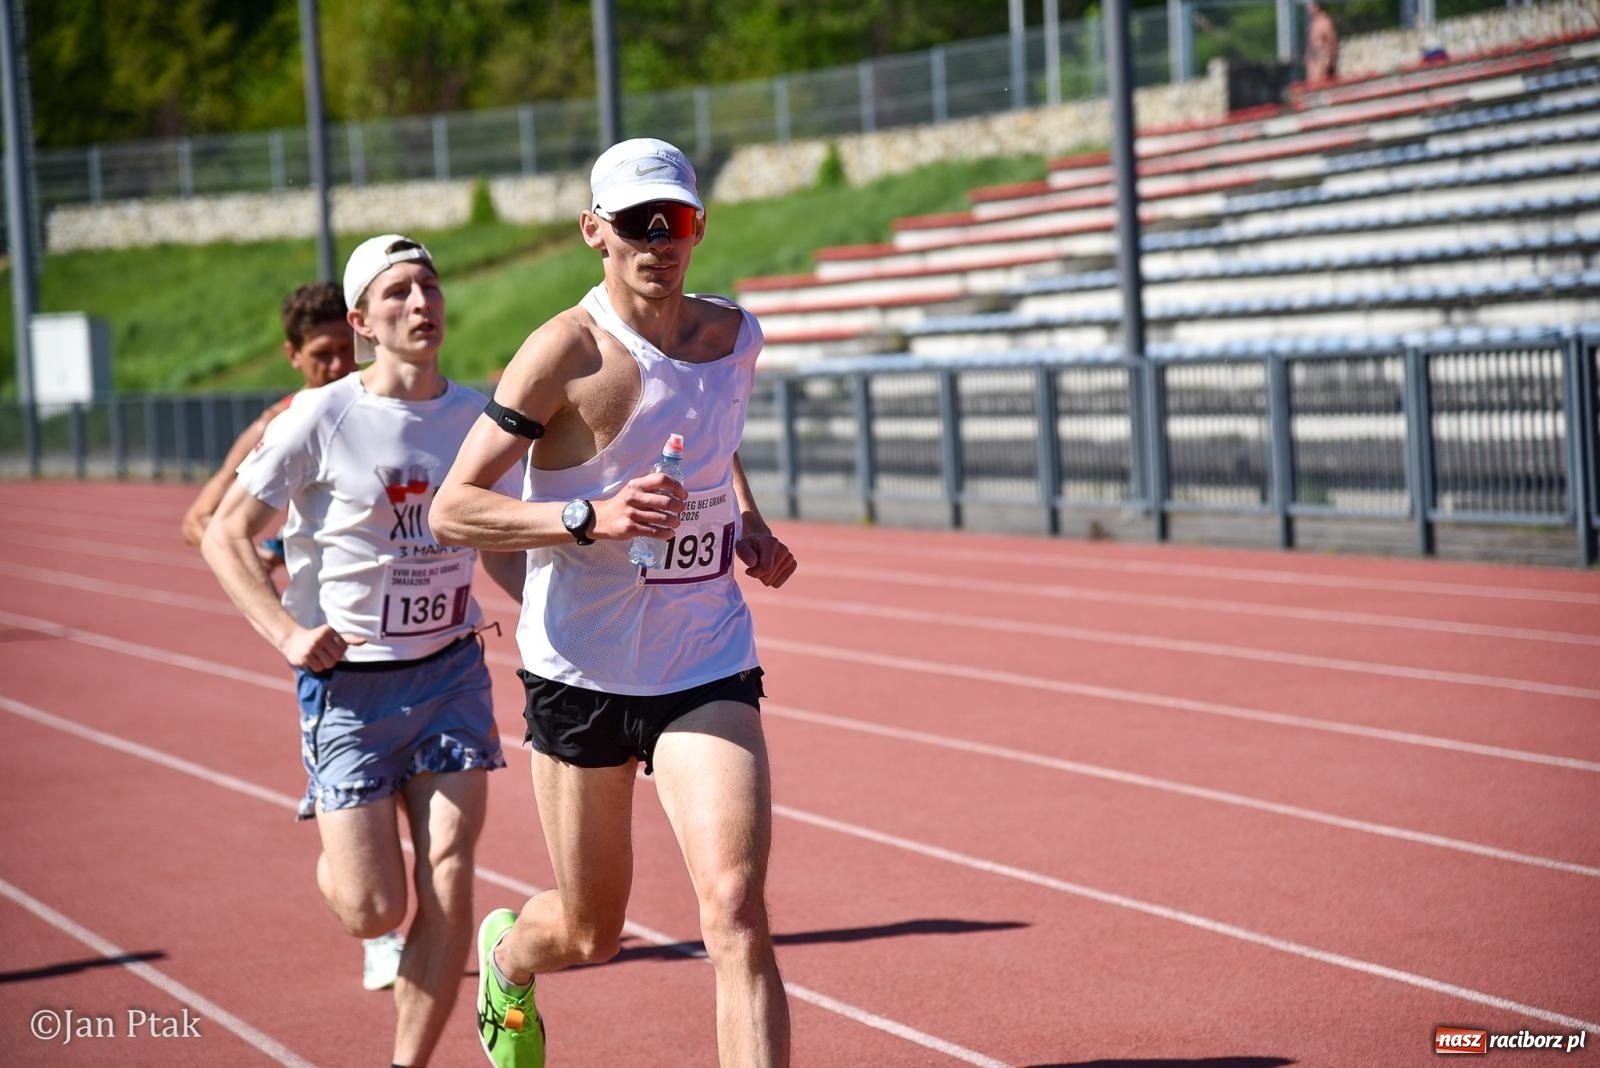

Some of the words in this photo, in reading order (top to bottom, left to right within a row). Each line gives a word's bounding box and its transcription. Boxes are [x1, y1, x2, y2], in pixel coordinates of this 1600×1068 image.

[697, 498, 709, 510] BEZ
[390, 503, 423, 541] XII
[399, 545, 408, 558] 3
[664, 531, 715, 570] 193
[401, 593, 447, 625] 136
